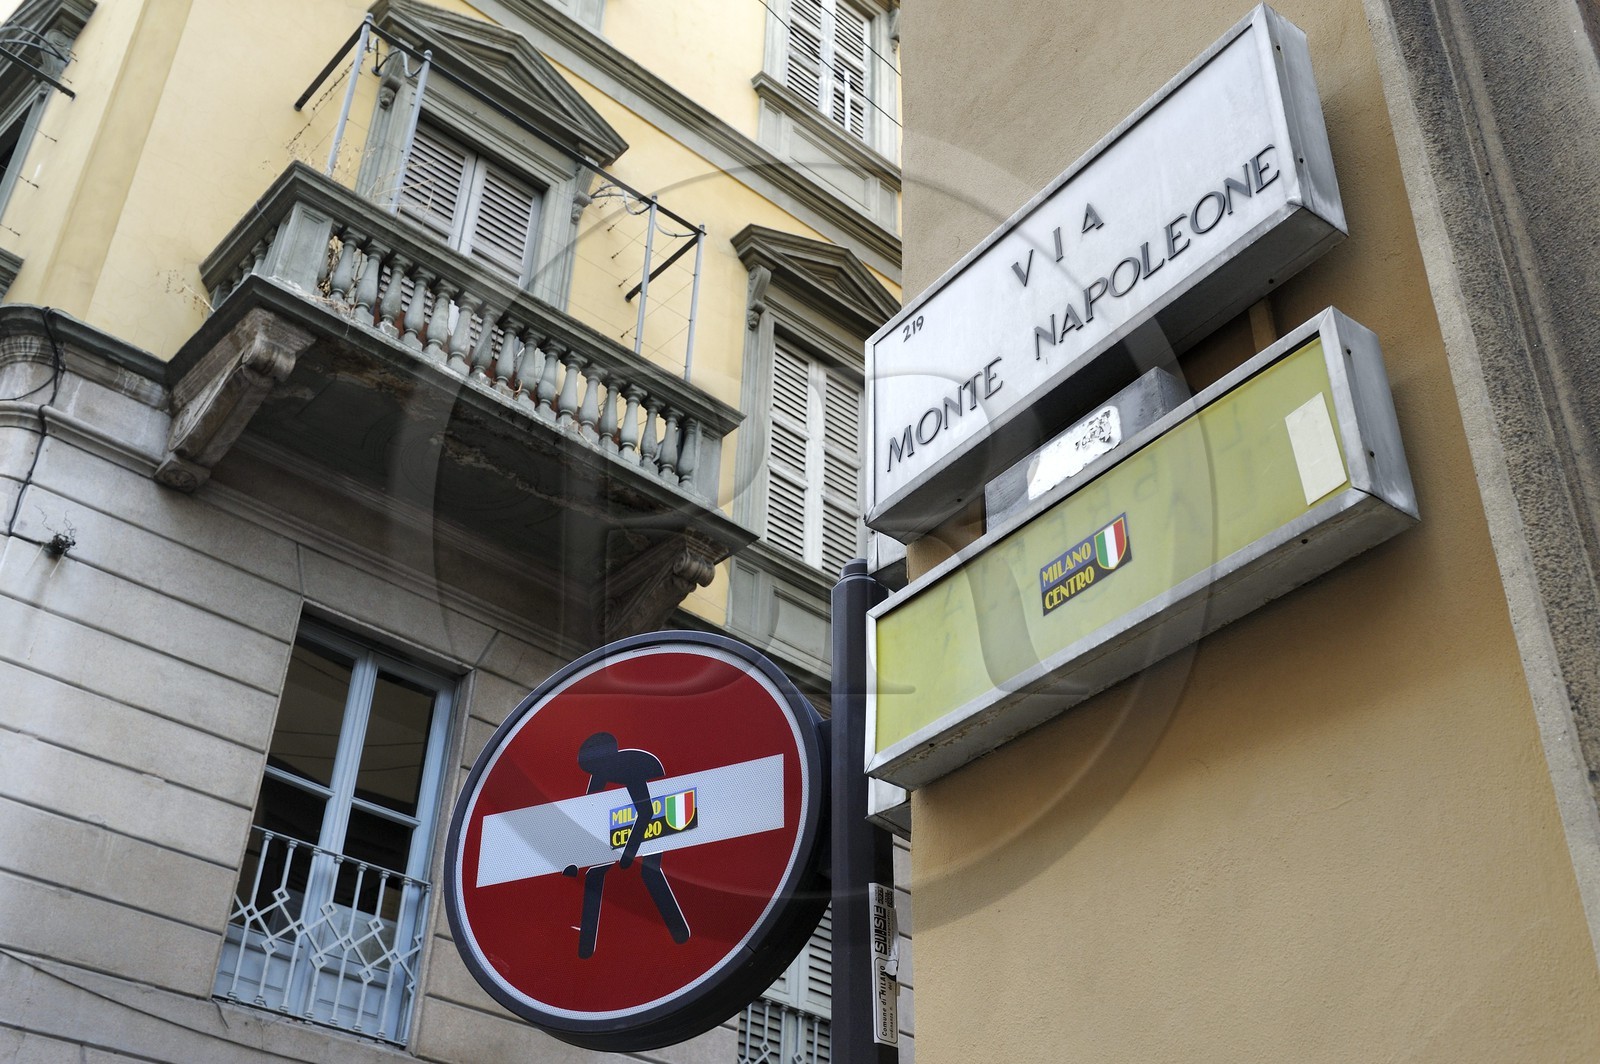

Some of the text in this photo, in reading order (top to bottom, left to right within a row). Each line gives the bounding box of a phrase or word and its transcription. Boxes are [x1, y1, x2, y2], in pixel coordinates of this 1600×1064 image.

[1011, 202, 1104, 287] VIA
[886, 356, 1003, 472] MONTE
[1033, 144, 1281, 360] NAPOLEONE
[902, 315, 925, 343] 219
[1042, 542, 1092, 588] MILANO
[1044, 565, 1095, 610] CENTRO
[612, 800, 662, 826] MILO
[612, 820, 662, 846] CERO
